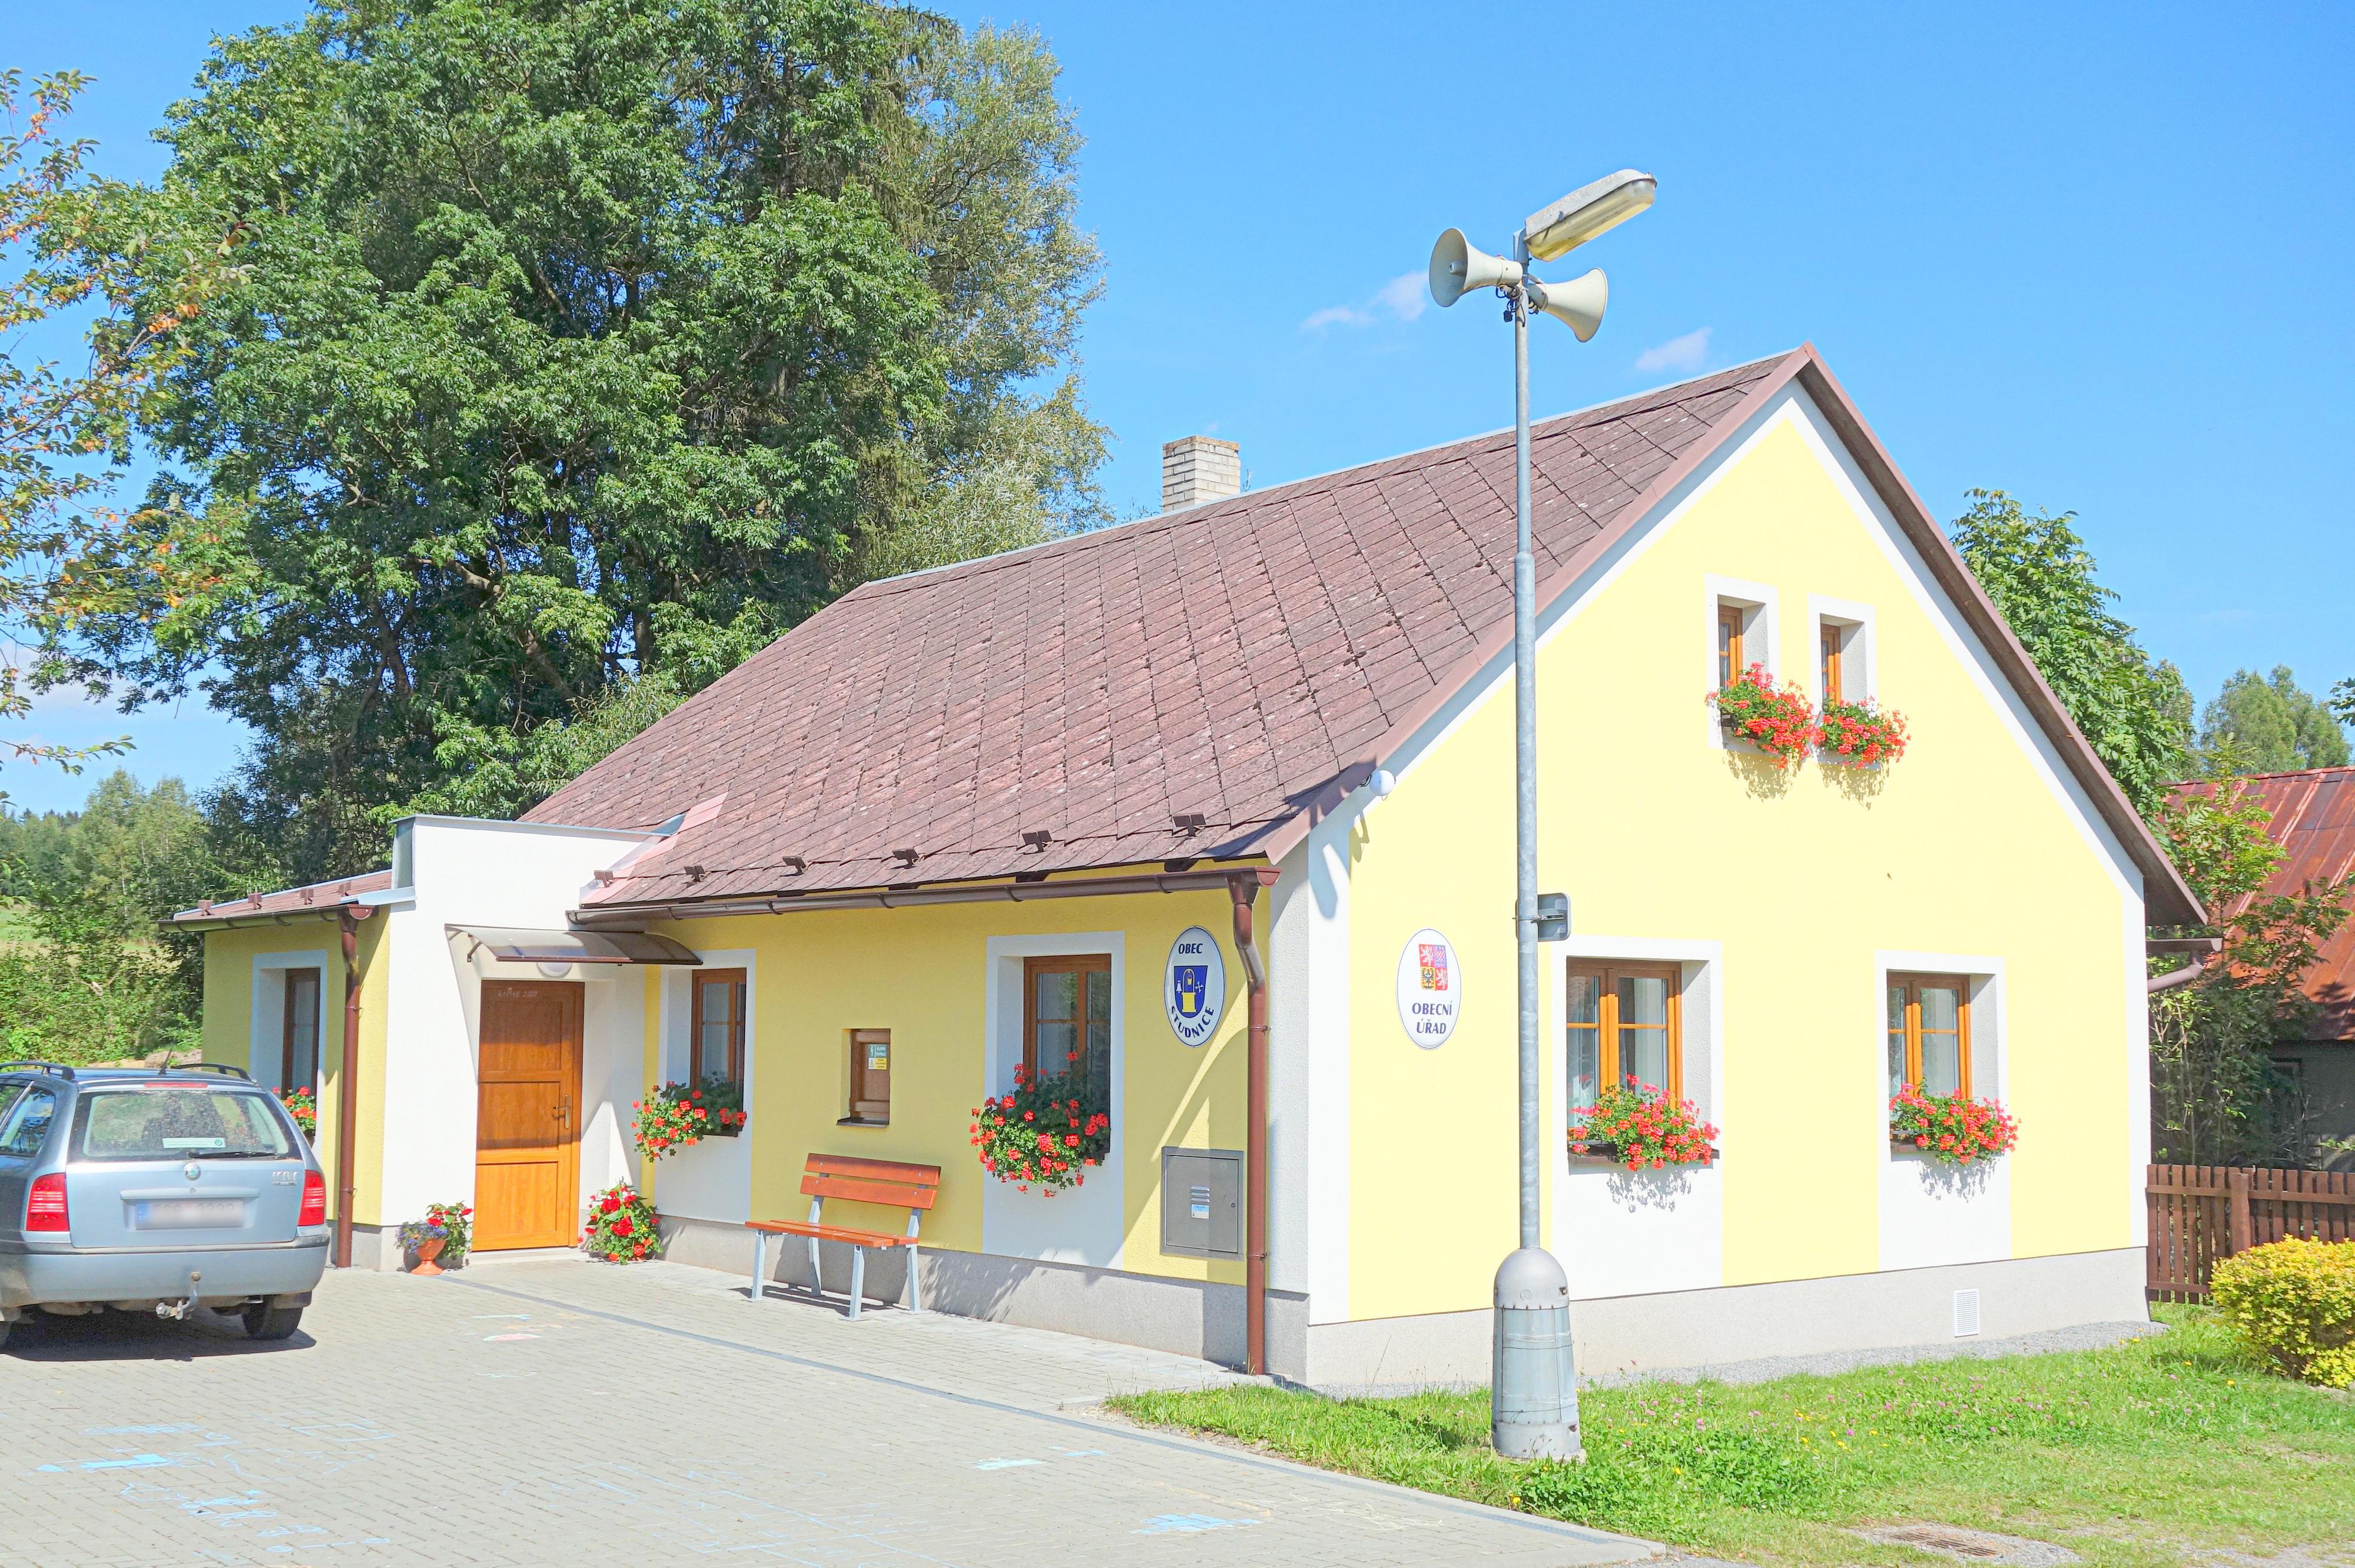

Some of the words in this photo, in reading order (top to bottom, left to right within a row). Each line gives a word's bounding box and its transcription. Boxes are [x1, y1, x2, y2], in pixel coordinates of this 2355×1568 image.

[1178, 943, 1203, 954] OBEC
[1412, 1000, 1452, 1016] OBECNÍ
[1171, 1006, 1215, 1038] STUDNICE
[1417, 1018, 1447, 1034] ÚŘAD
